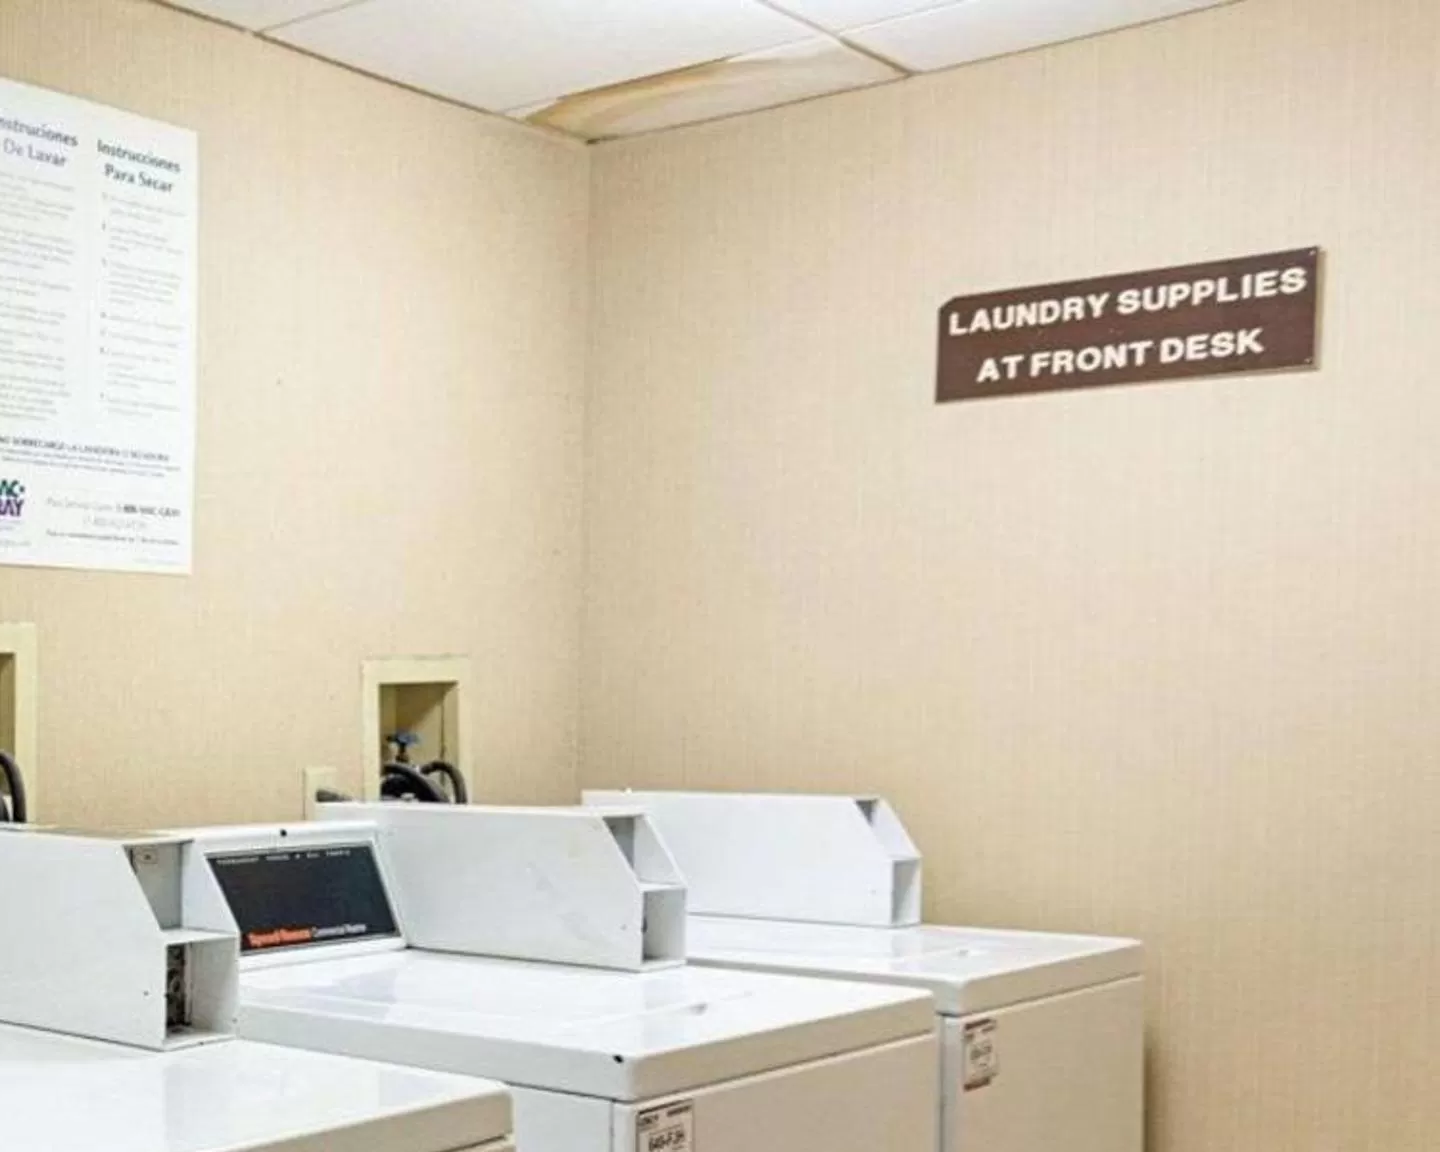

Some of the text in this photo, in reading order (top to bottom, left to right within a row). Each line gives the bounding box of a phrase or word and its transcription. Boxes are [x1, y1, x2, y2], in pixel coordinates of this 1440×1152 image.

[105, 163, 135, 184] Para
[949, 266, 1307, 337] LAUNDRY SUPPLIES
[976, 328, 1265, 384] AT FRONT DESK
